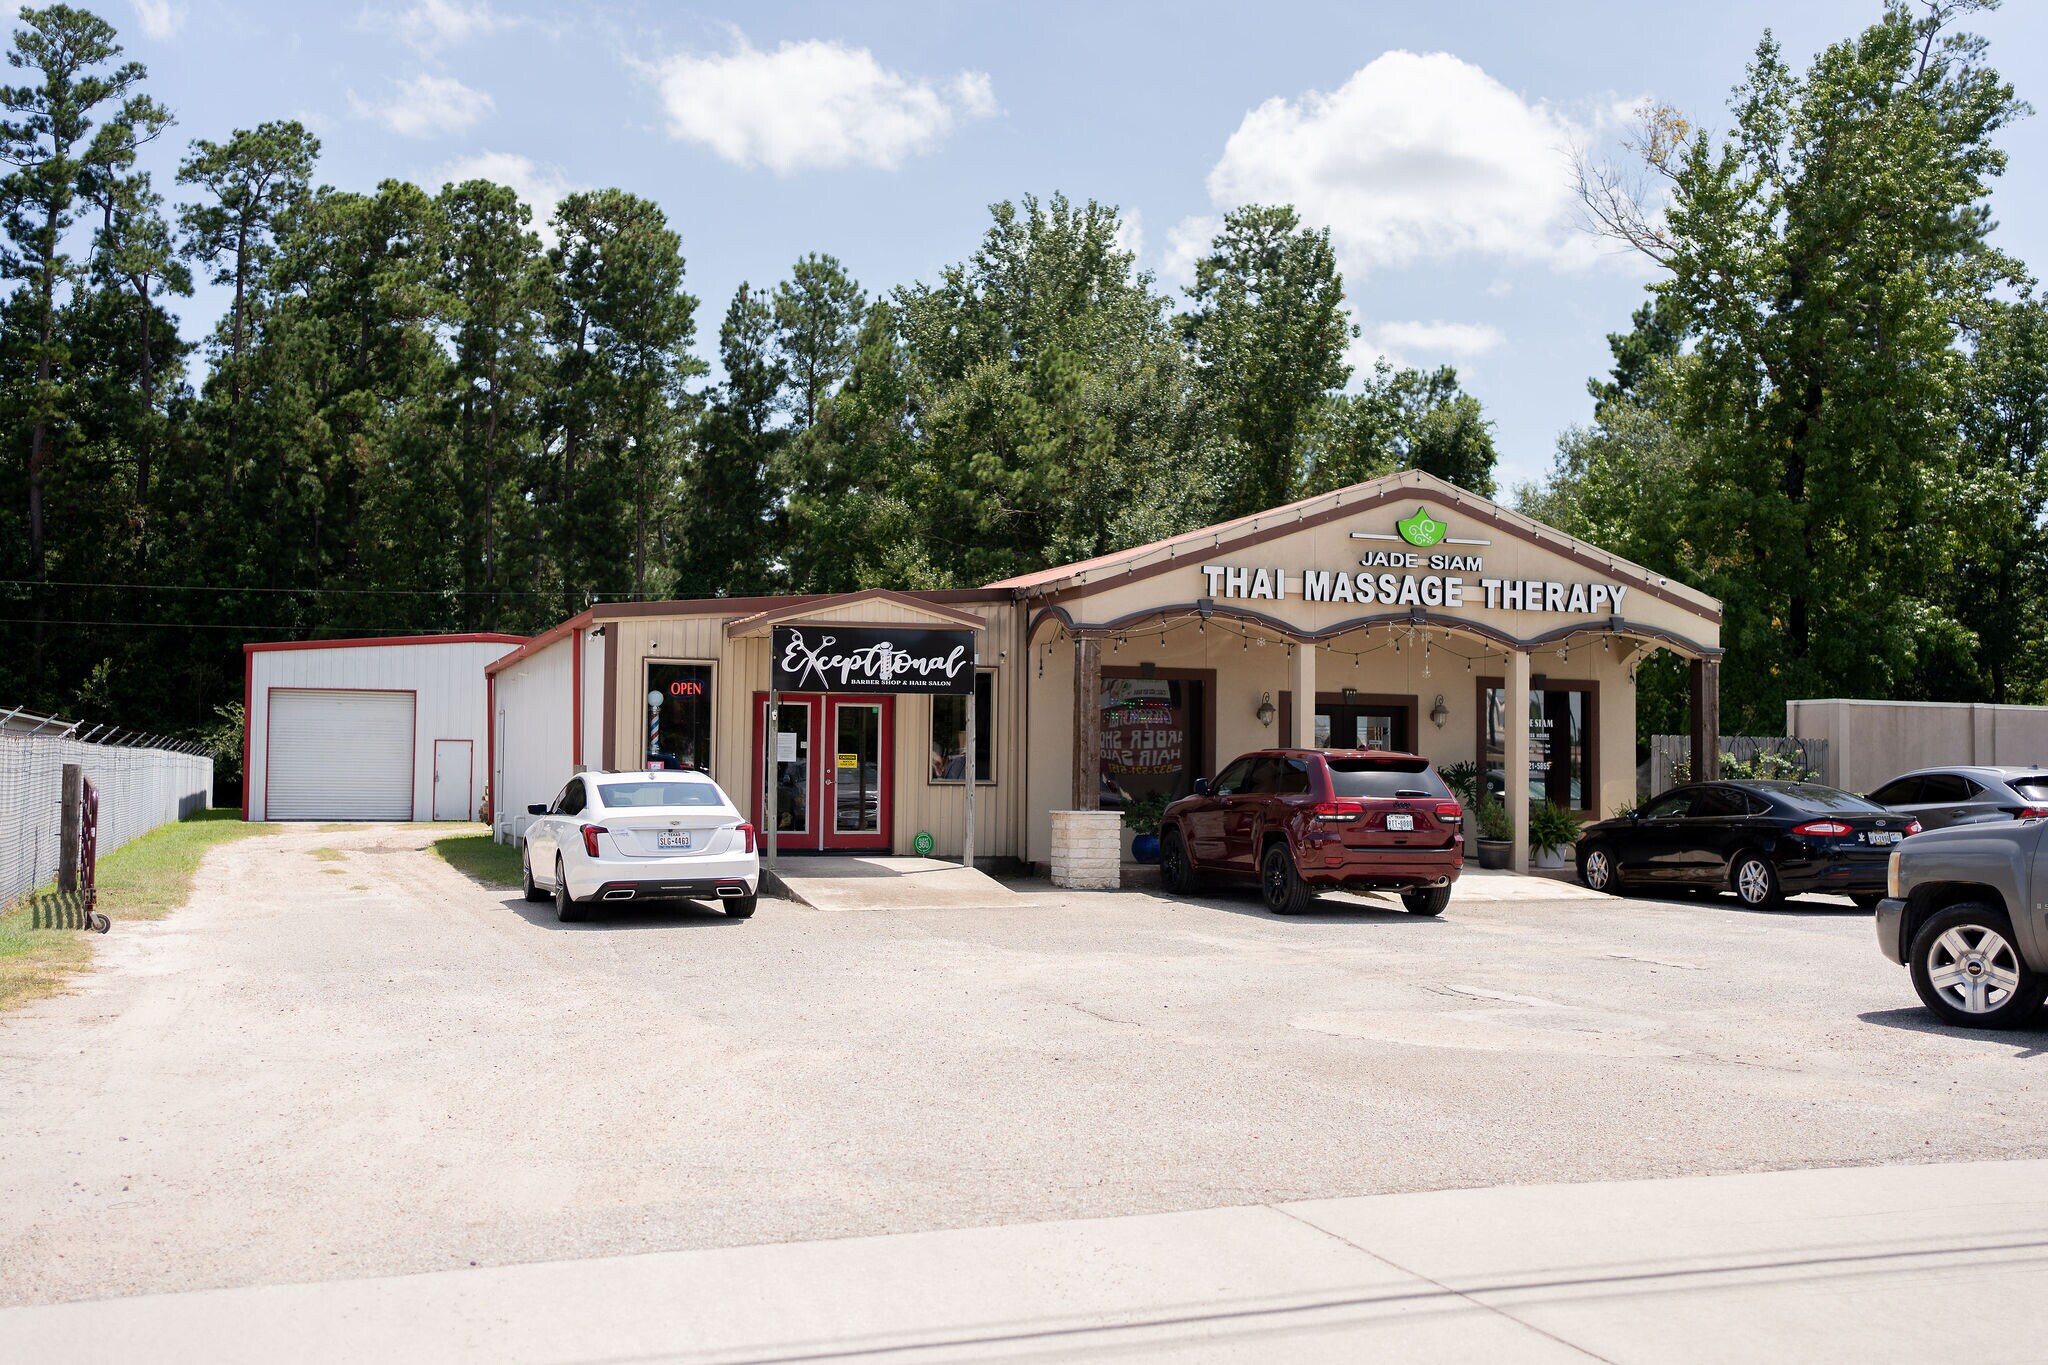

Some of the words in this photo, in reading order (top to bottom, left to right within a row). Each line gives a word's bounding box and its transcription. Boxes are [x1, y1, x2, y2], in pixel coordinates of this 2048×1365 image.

[1360, 551, 1419, 568] JADE
[1430, 554, 1483, 572] SIAM
[1202, 565, 1286, 600] THAI
[1304, 570, 1463, 607] MASSAGE
[1480, 579, 1628, 614] THERAPY
[670, 682, 702, 695] OPEN
[1534, 719, 1554, 728] SIAM
